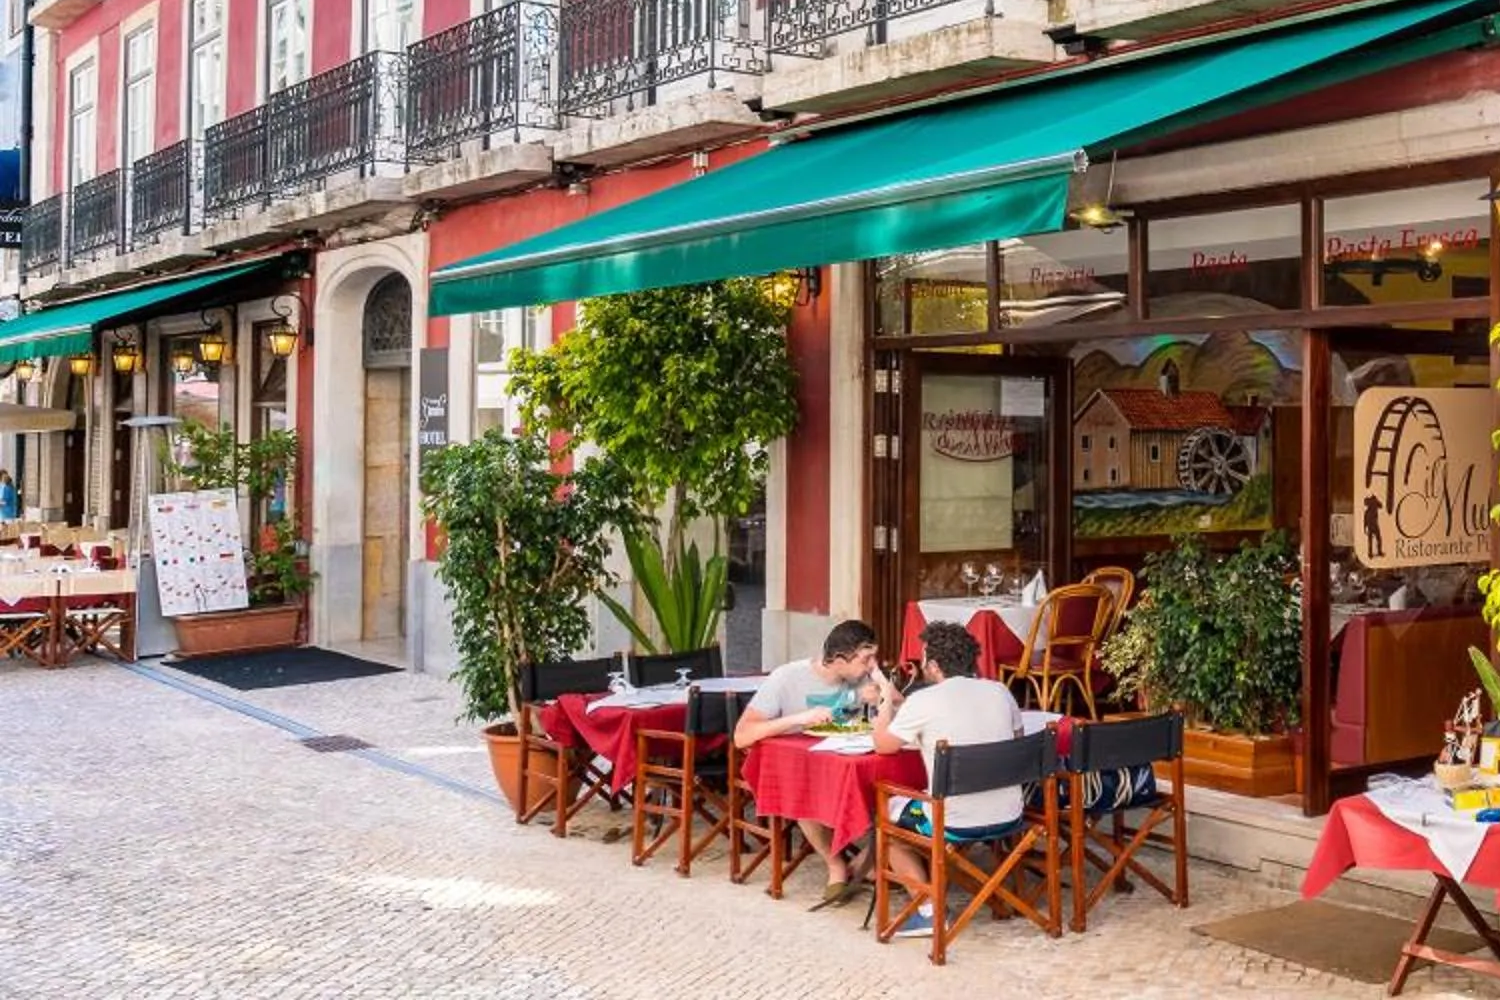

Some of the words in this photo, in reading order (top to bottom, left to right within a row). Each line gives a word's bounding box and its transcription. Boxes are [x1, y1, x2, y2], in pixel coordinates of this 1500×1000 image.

[1326, 234, 1392, 258] Pasta
[1190, 249, 1248, 273] Pasta
[1395, 537, 1473, 559] Ristorante
